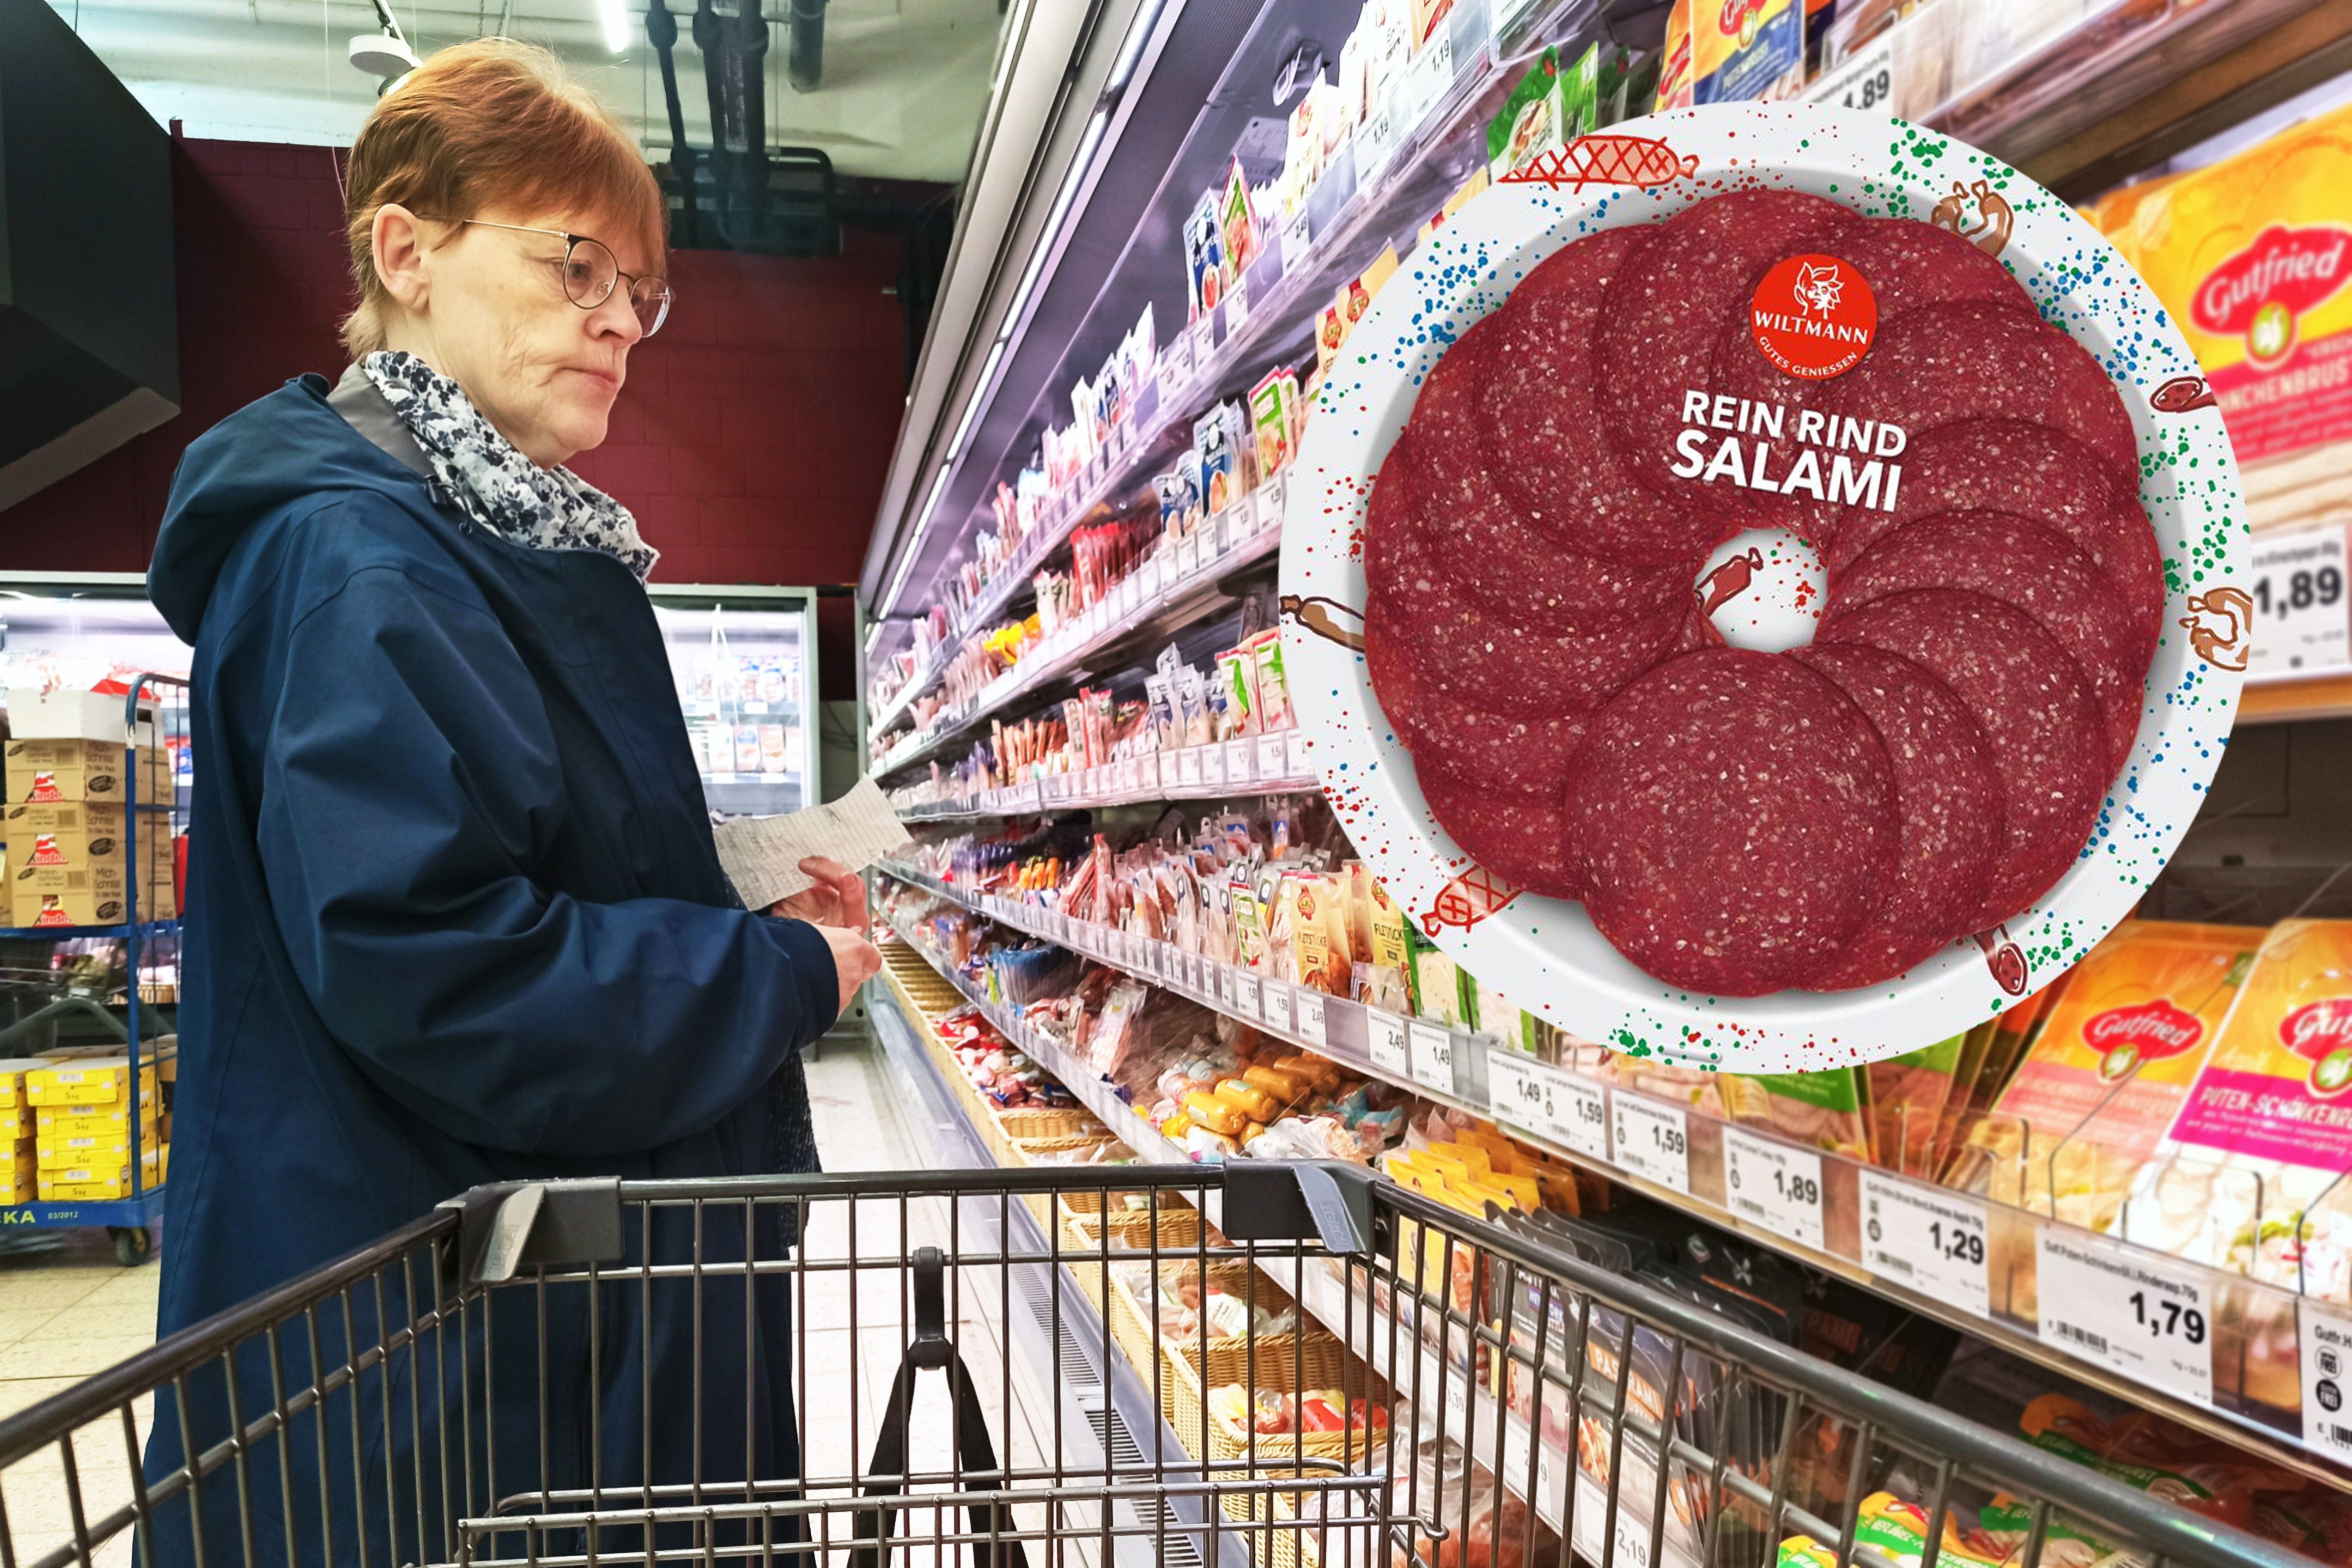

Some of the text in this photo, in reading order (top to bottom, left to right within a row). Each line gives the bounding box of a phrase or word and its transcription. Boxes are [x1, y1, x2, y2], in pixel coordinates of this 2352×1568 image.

[2205, 239, 2345, 327] Gutfried
[2253, 566, 2342, 621] 1,89
[1388, 1030, 1404, 1050] 2,49
[2093, 1011, 2198, 1048] Gutfried
[1433, 1046, 1450, 1066] 1,49
[1517, 1078, 1541, 1103] 1,49
[1576, 1098, 1603, 1125] 1,59
[1652, 1124, 1685, 1155] 1,59
[1773, 1169, 1818, 1206] 1,89
[0, 1211, 36, 1224] KA
[1929, 1221, 1984, 1266] 1,29
[2129, 1291, 2205, 1345] 1,79
[1595, 1347, 1660, 1417] PASRAMI
[1617, 1527, 1646, 1566] 2,19
